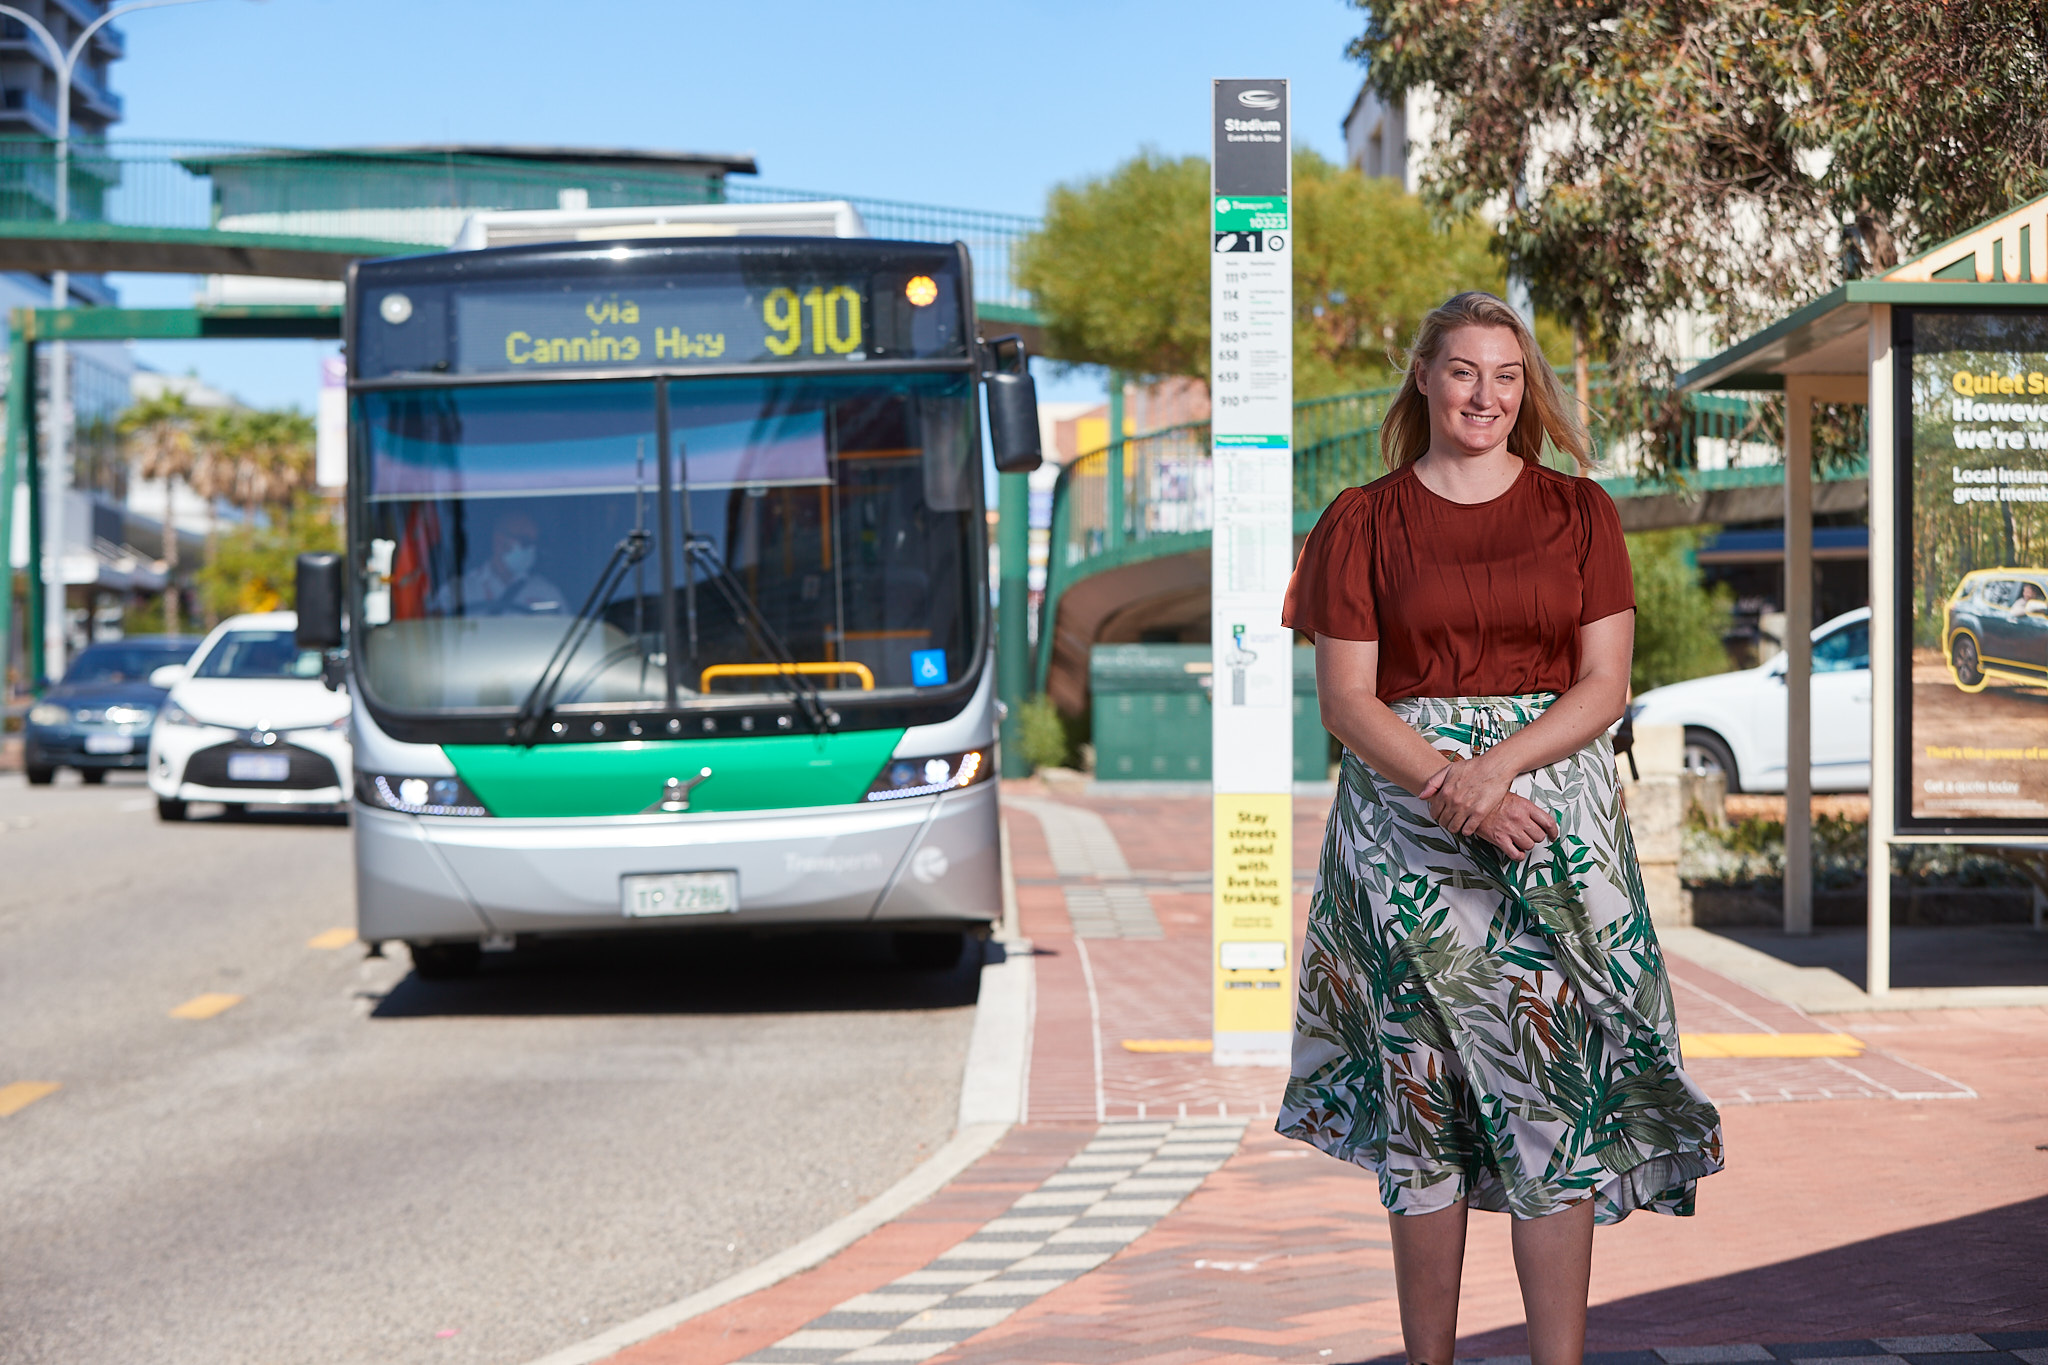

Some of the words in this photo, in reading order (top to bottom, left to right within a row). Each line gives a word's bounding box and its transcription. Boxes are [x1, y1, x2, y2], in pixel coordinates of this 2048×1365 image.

[1224, 118, 1281, 132] Stadium
[1249, 133, 1263, 142] Bus
[1249, 217, 1287, 229] 10323
[1223, 290, 1239, 300] 114
[763, 285, 862, 356] 910
[1223, 311, 1239, 321] 115
[1221, 332, 1239, 342] 160
[506, 329, 641, 364] Canning
[655, 326, 725, 359] Hwy
[1953, 371, 2025, 397] Quiet
[1220, 396, 1239, 406] 910
[1953, 466, 1998, 484] Local
[1953, 485, 1999, 504] great
[1923, 779, 1945, 793] Get
[1946, 781, 1954, 793] a
[1988, 780, 2019, 795] today
[1238, 812, 1268, 824] Stay
[1229, 830, 1277, 839] streets
[1233, 845, 1273, 854] ahead
[1238, 862, 1269, 871] with
[1254, 877, 1278, 887] bus
[1223, 893, 1281, 906] tracking
